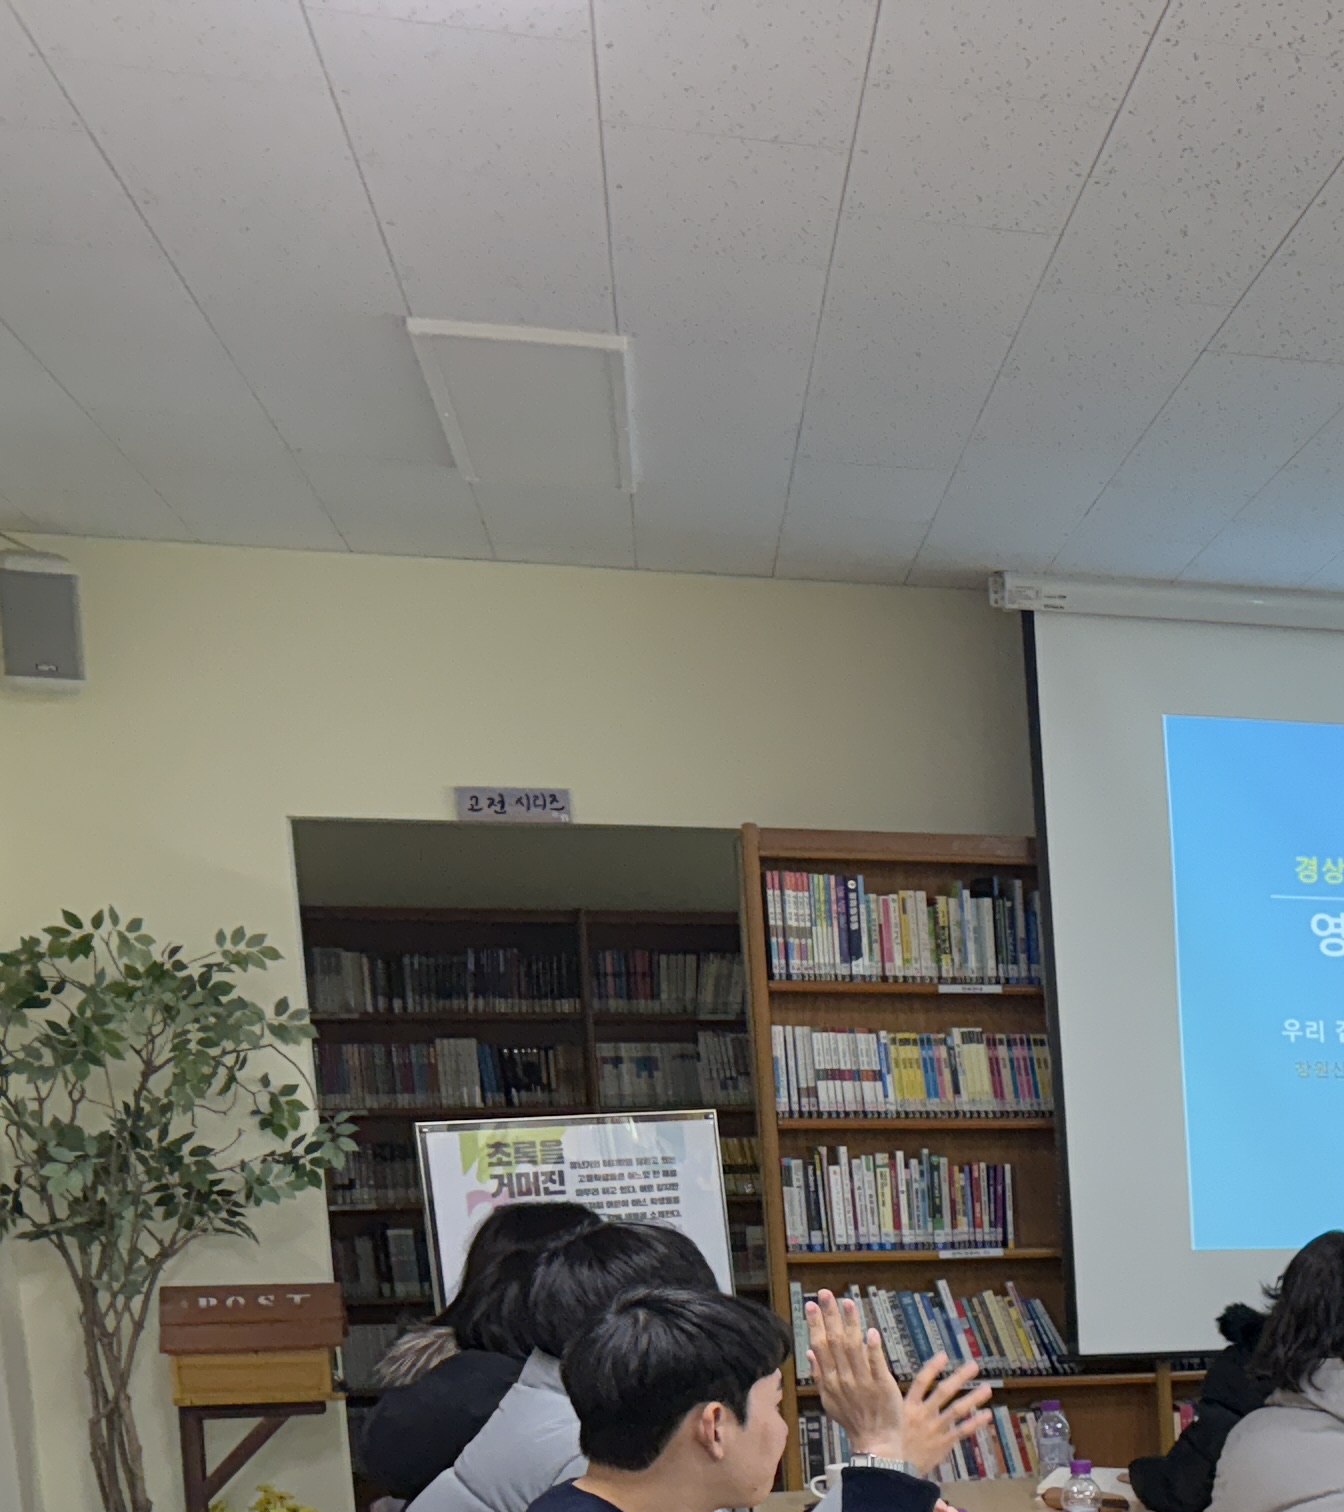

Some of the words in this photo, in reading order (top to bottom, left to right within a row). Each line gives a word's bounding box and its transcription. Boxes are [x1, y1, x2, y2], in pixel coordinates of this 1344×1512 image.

[467, 792, 507, 814] 고전
[515, 792, 565, 812] 시리즈
[1281, 1018, 1326, 1044] 우리
